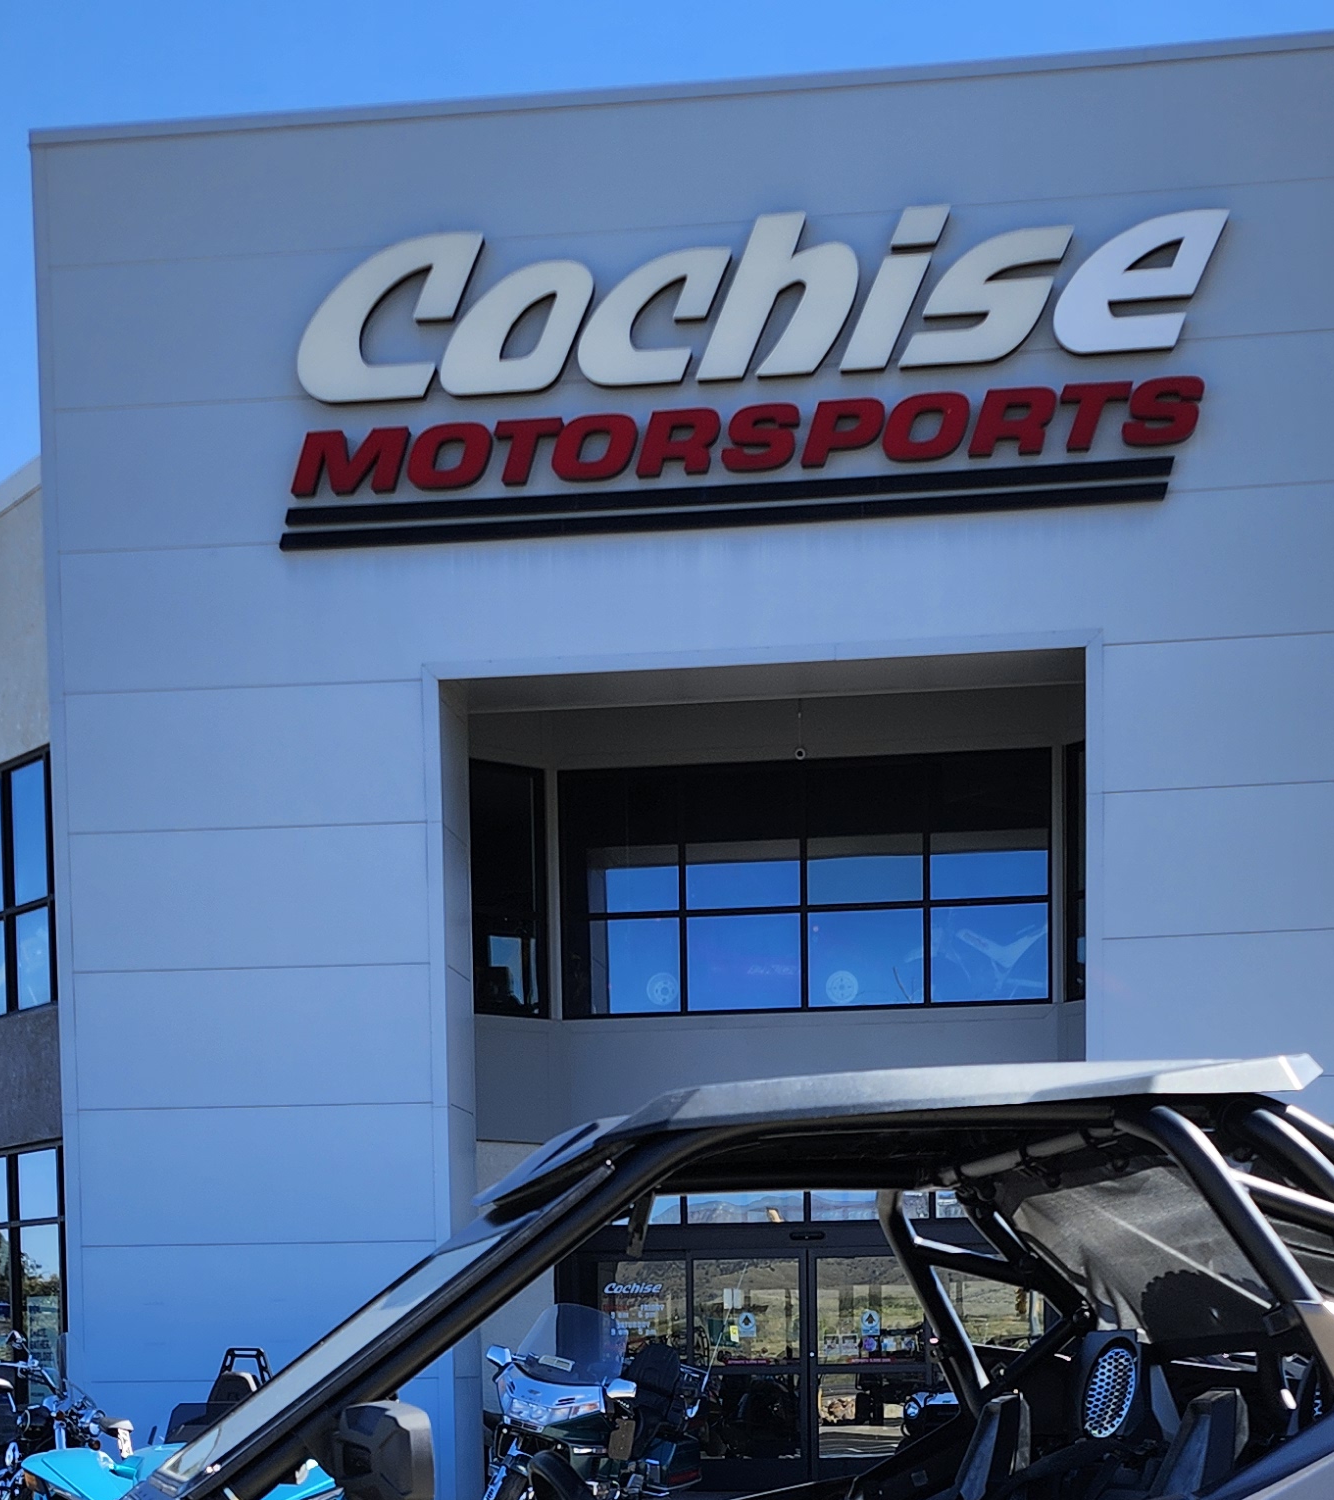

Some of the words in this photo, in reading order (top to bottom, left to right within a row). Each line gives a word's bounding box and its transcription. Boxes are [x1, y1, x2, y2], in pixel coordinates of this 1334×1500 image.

[296, 204, 1229, 403] Cochise
[291, 375, 1205, 496] MOTORSPORTS
[603, 1282, 663, 1294] Cochise
